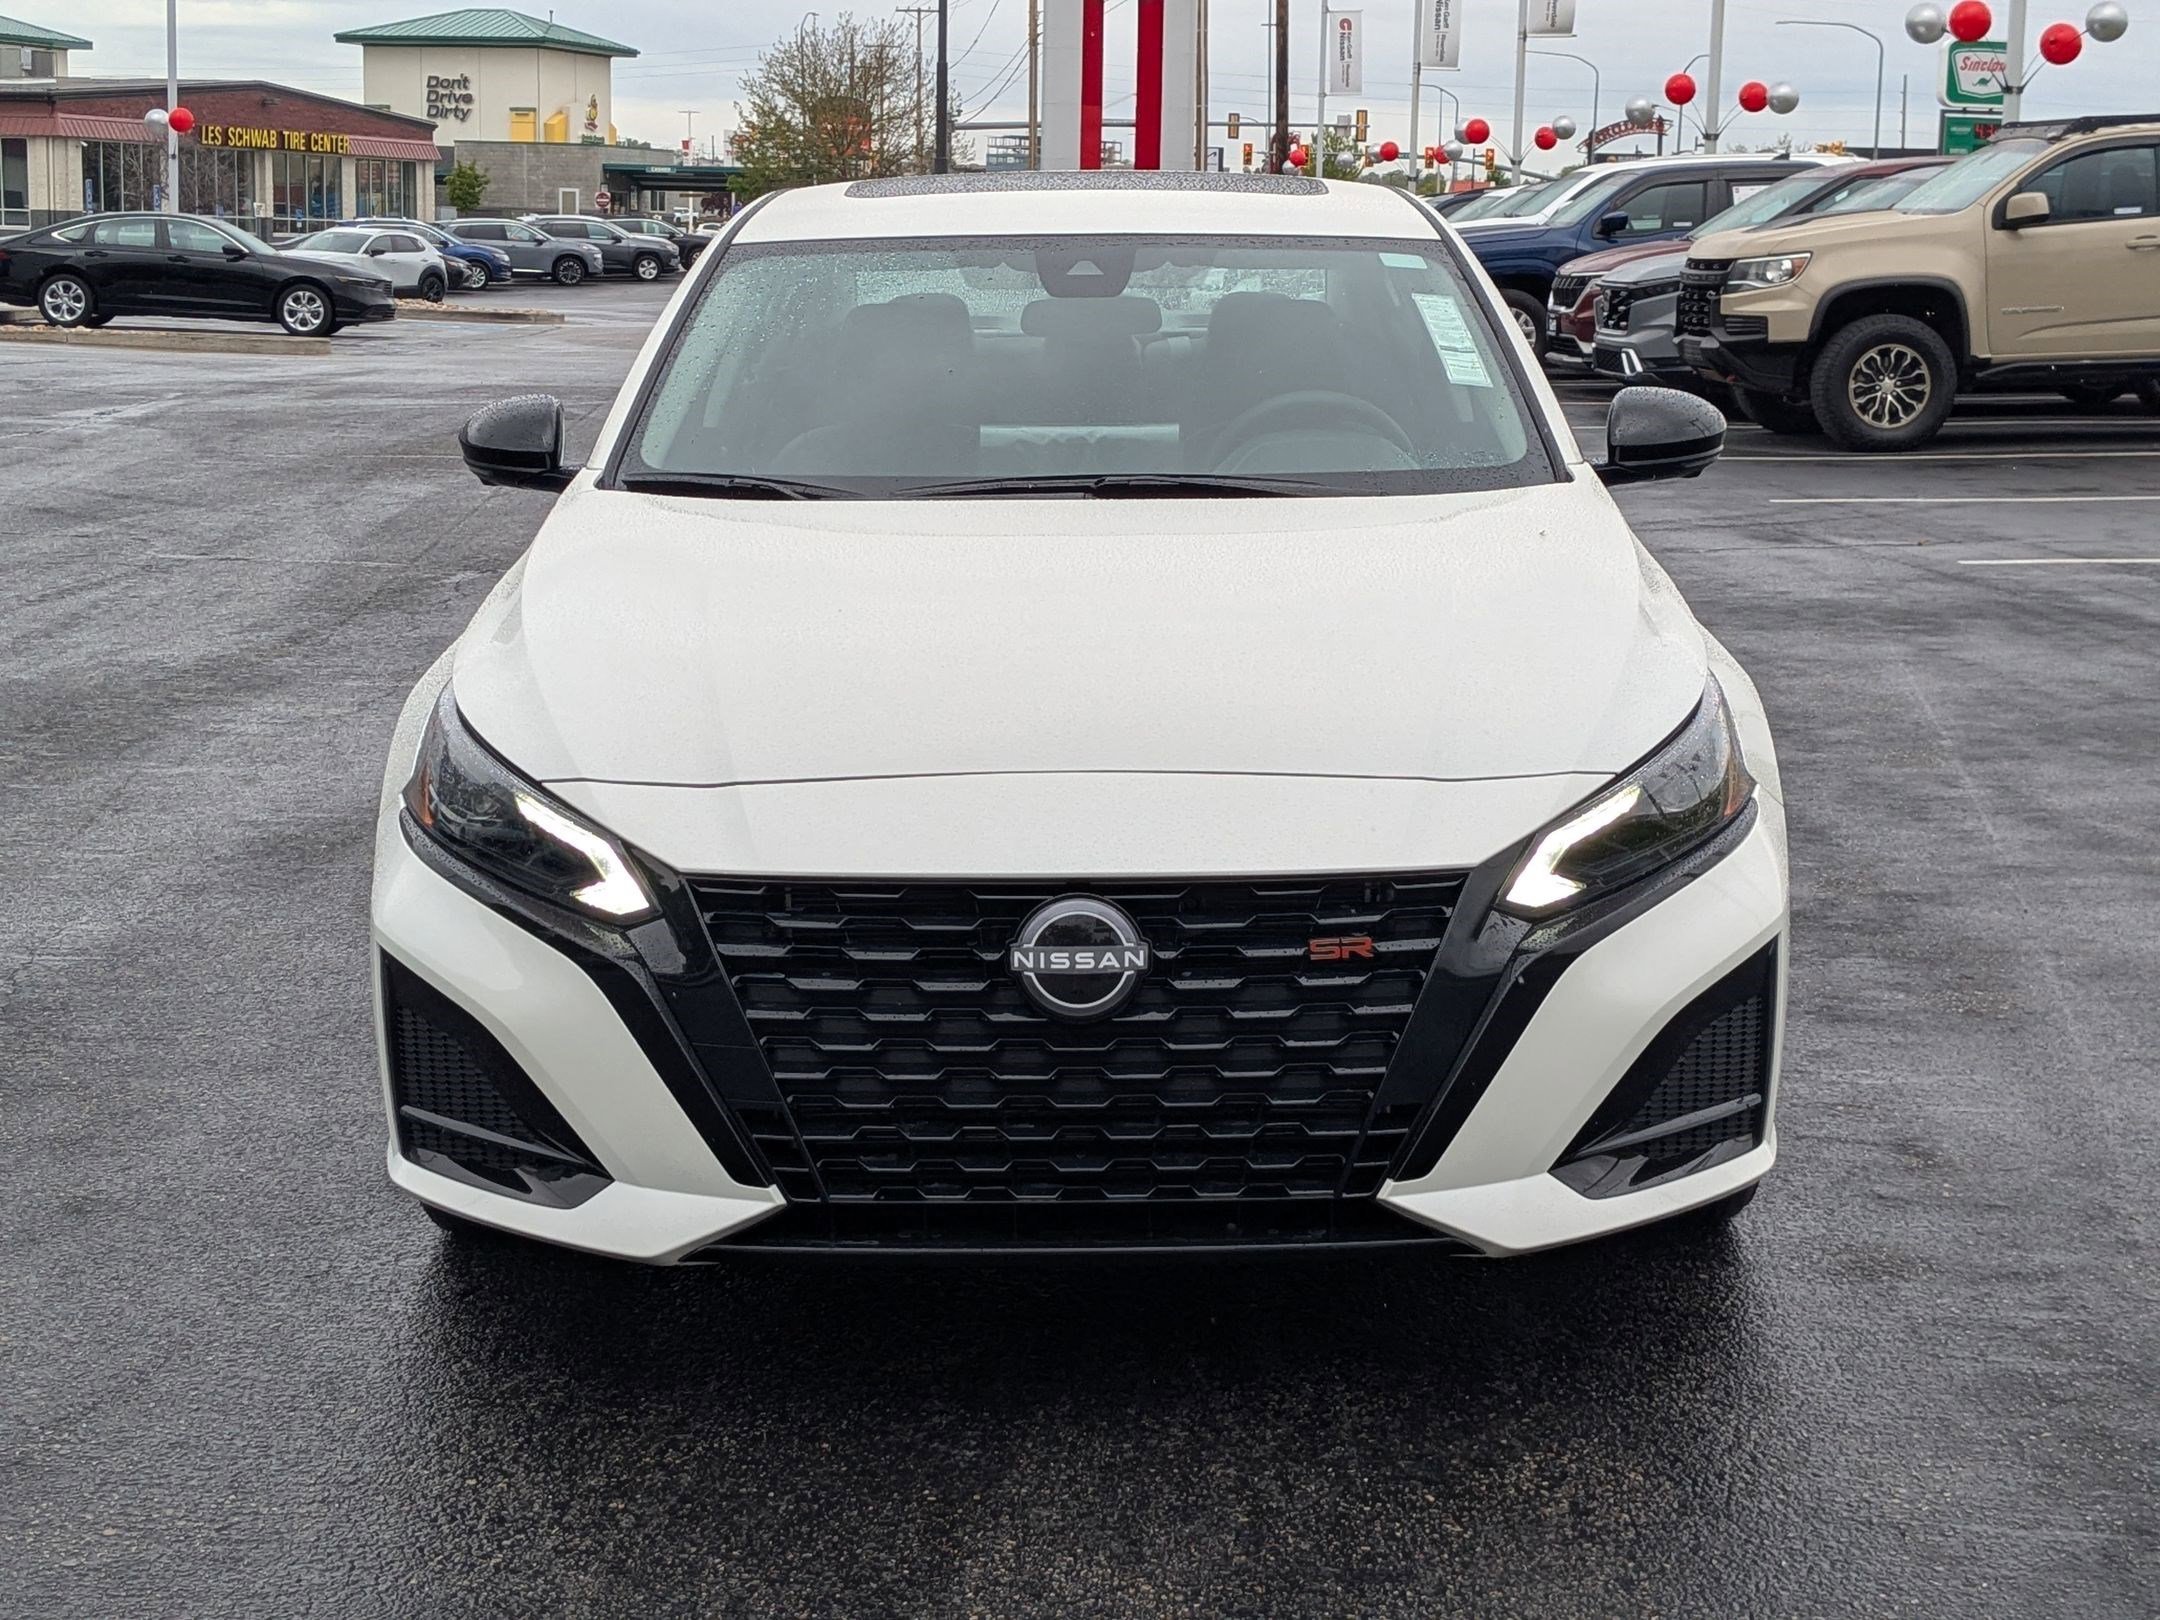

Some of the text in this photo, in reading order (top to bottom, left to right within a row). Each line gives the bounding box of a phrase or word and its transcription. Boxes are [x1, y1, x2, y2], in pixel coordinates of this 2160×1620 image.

[426, 73, 470, 89] Don't
[426, 90, 473, 104] Drive
[426, 104, 472, 122] Dirty
[201, 125, 350, 154] LES SCHWAB TIRE CENTER
[1308, 936, 1375, 961] SR
[1013, 950, 1145, 970] NISSAN
